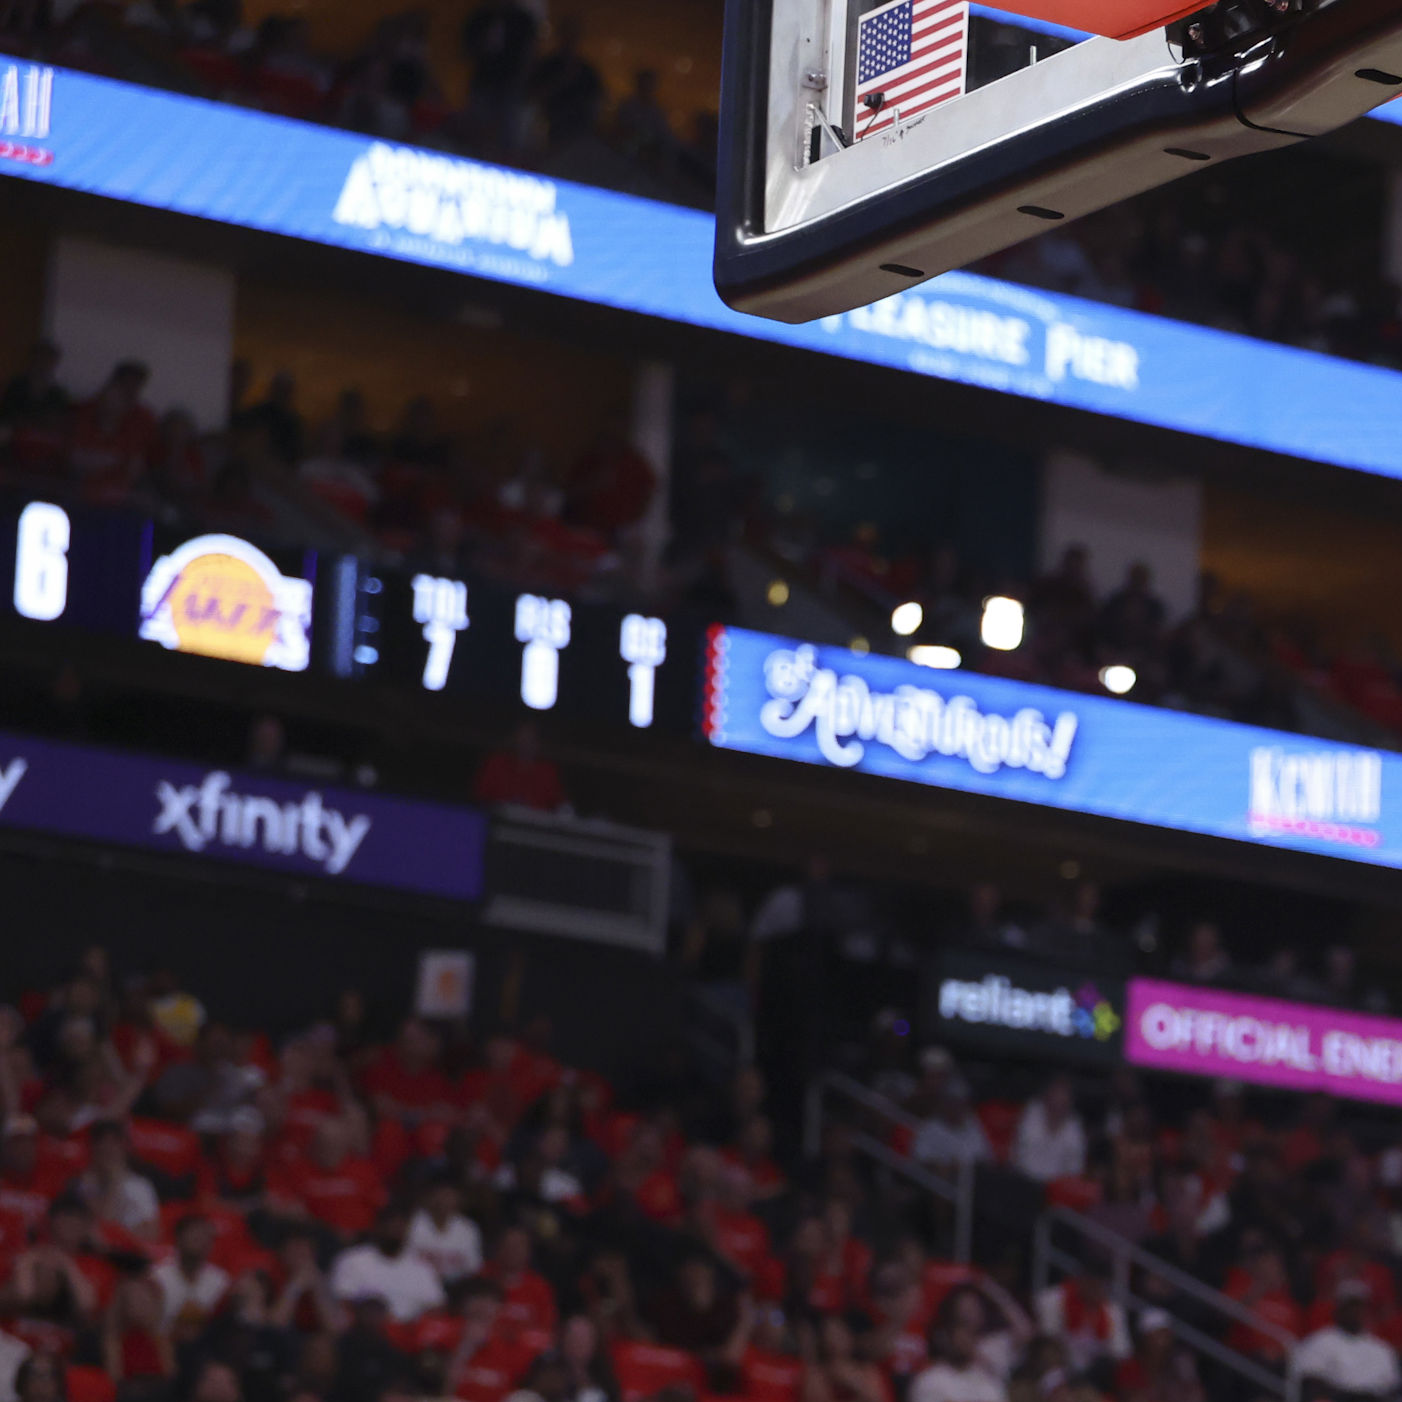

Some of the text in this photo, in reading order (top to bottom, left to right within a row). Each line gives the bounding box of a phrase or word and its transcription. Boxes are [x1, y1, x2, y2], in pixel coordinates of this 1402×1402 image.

[15, 502, 70, 621] 6
[153, 769, 371, 875] xfinity
[938, 973, 1074, 1036] reliant
[1140, 1003, 1319, 1072] OFFICIAL
